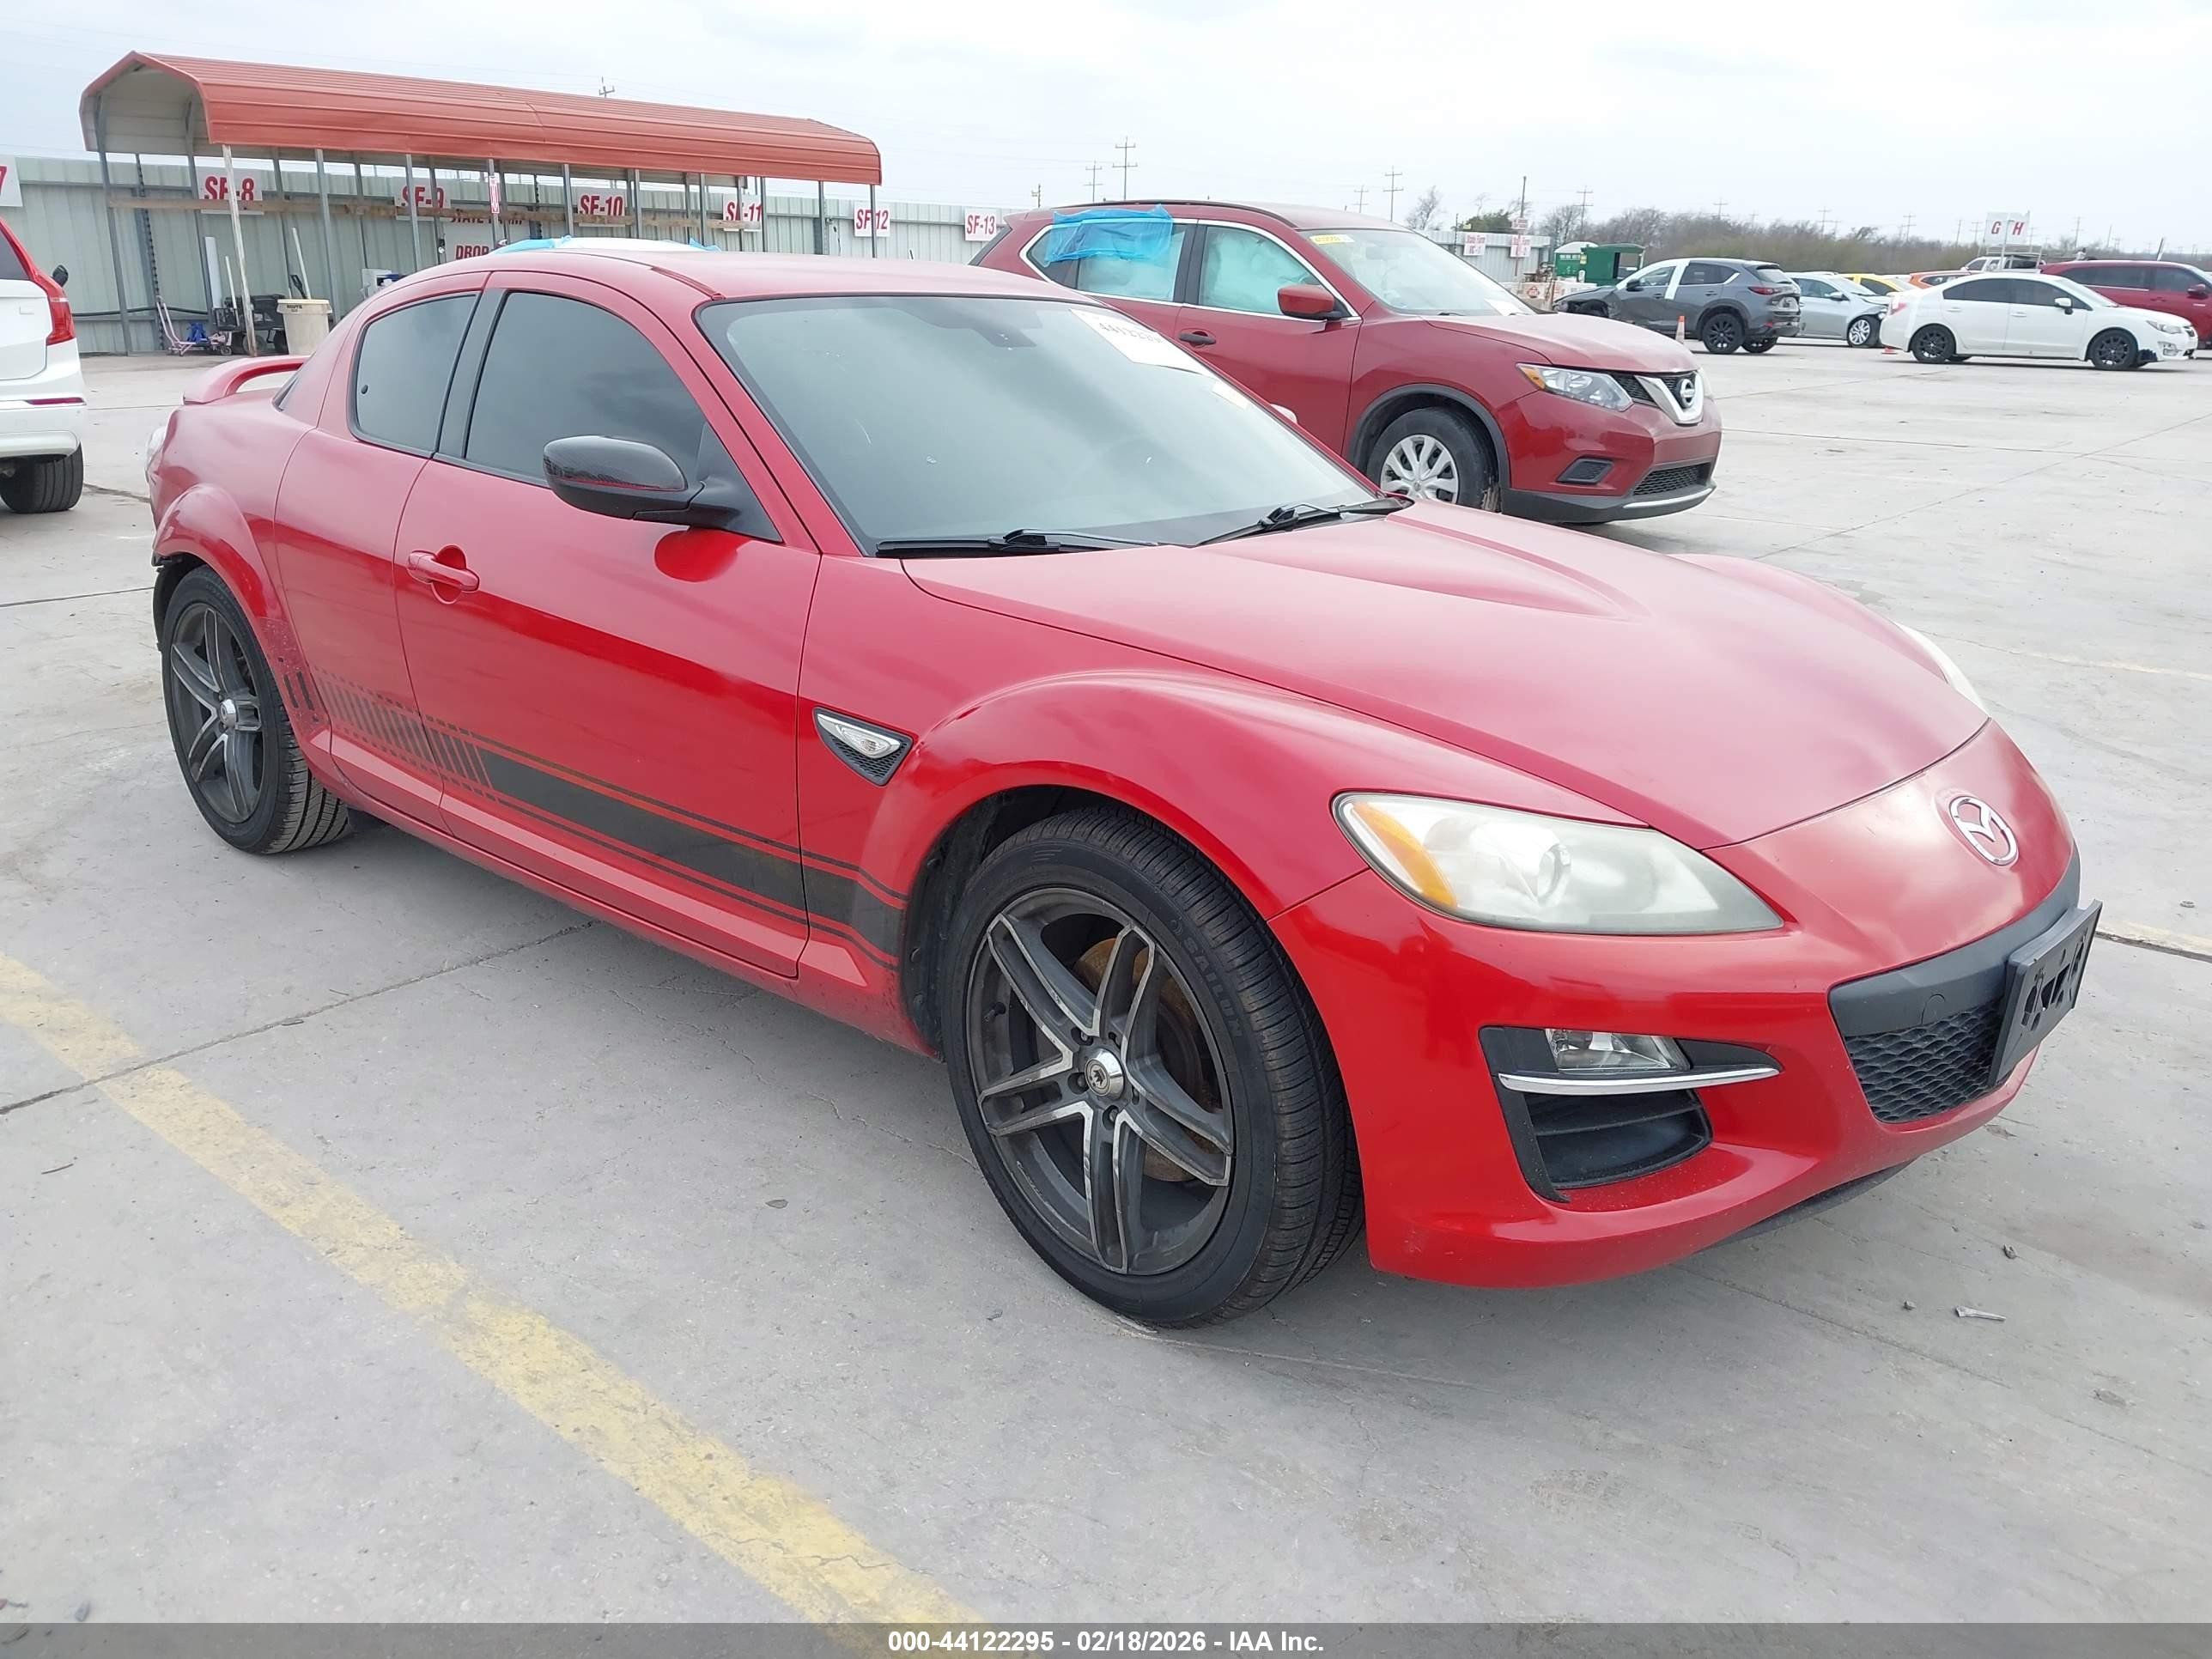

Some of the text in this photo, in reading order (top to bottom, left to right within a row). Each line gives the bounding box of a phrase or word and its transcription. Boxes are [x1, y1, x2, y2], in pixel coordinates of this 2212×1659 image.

[580, 194, 623, 216] SF-10
[856, 209, 889, 230] SF12
[967, 215, 995, 235] SF-13
[1991, 221, 2002, 234] G
[2012, 222, 2025, 235] H
[1183, 936, 1243, 1037] SAILUN
